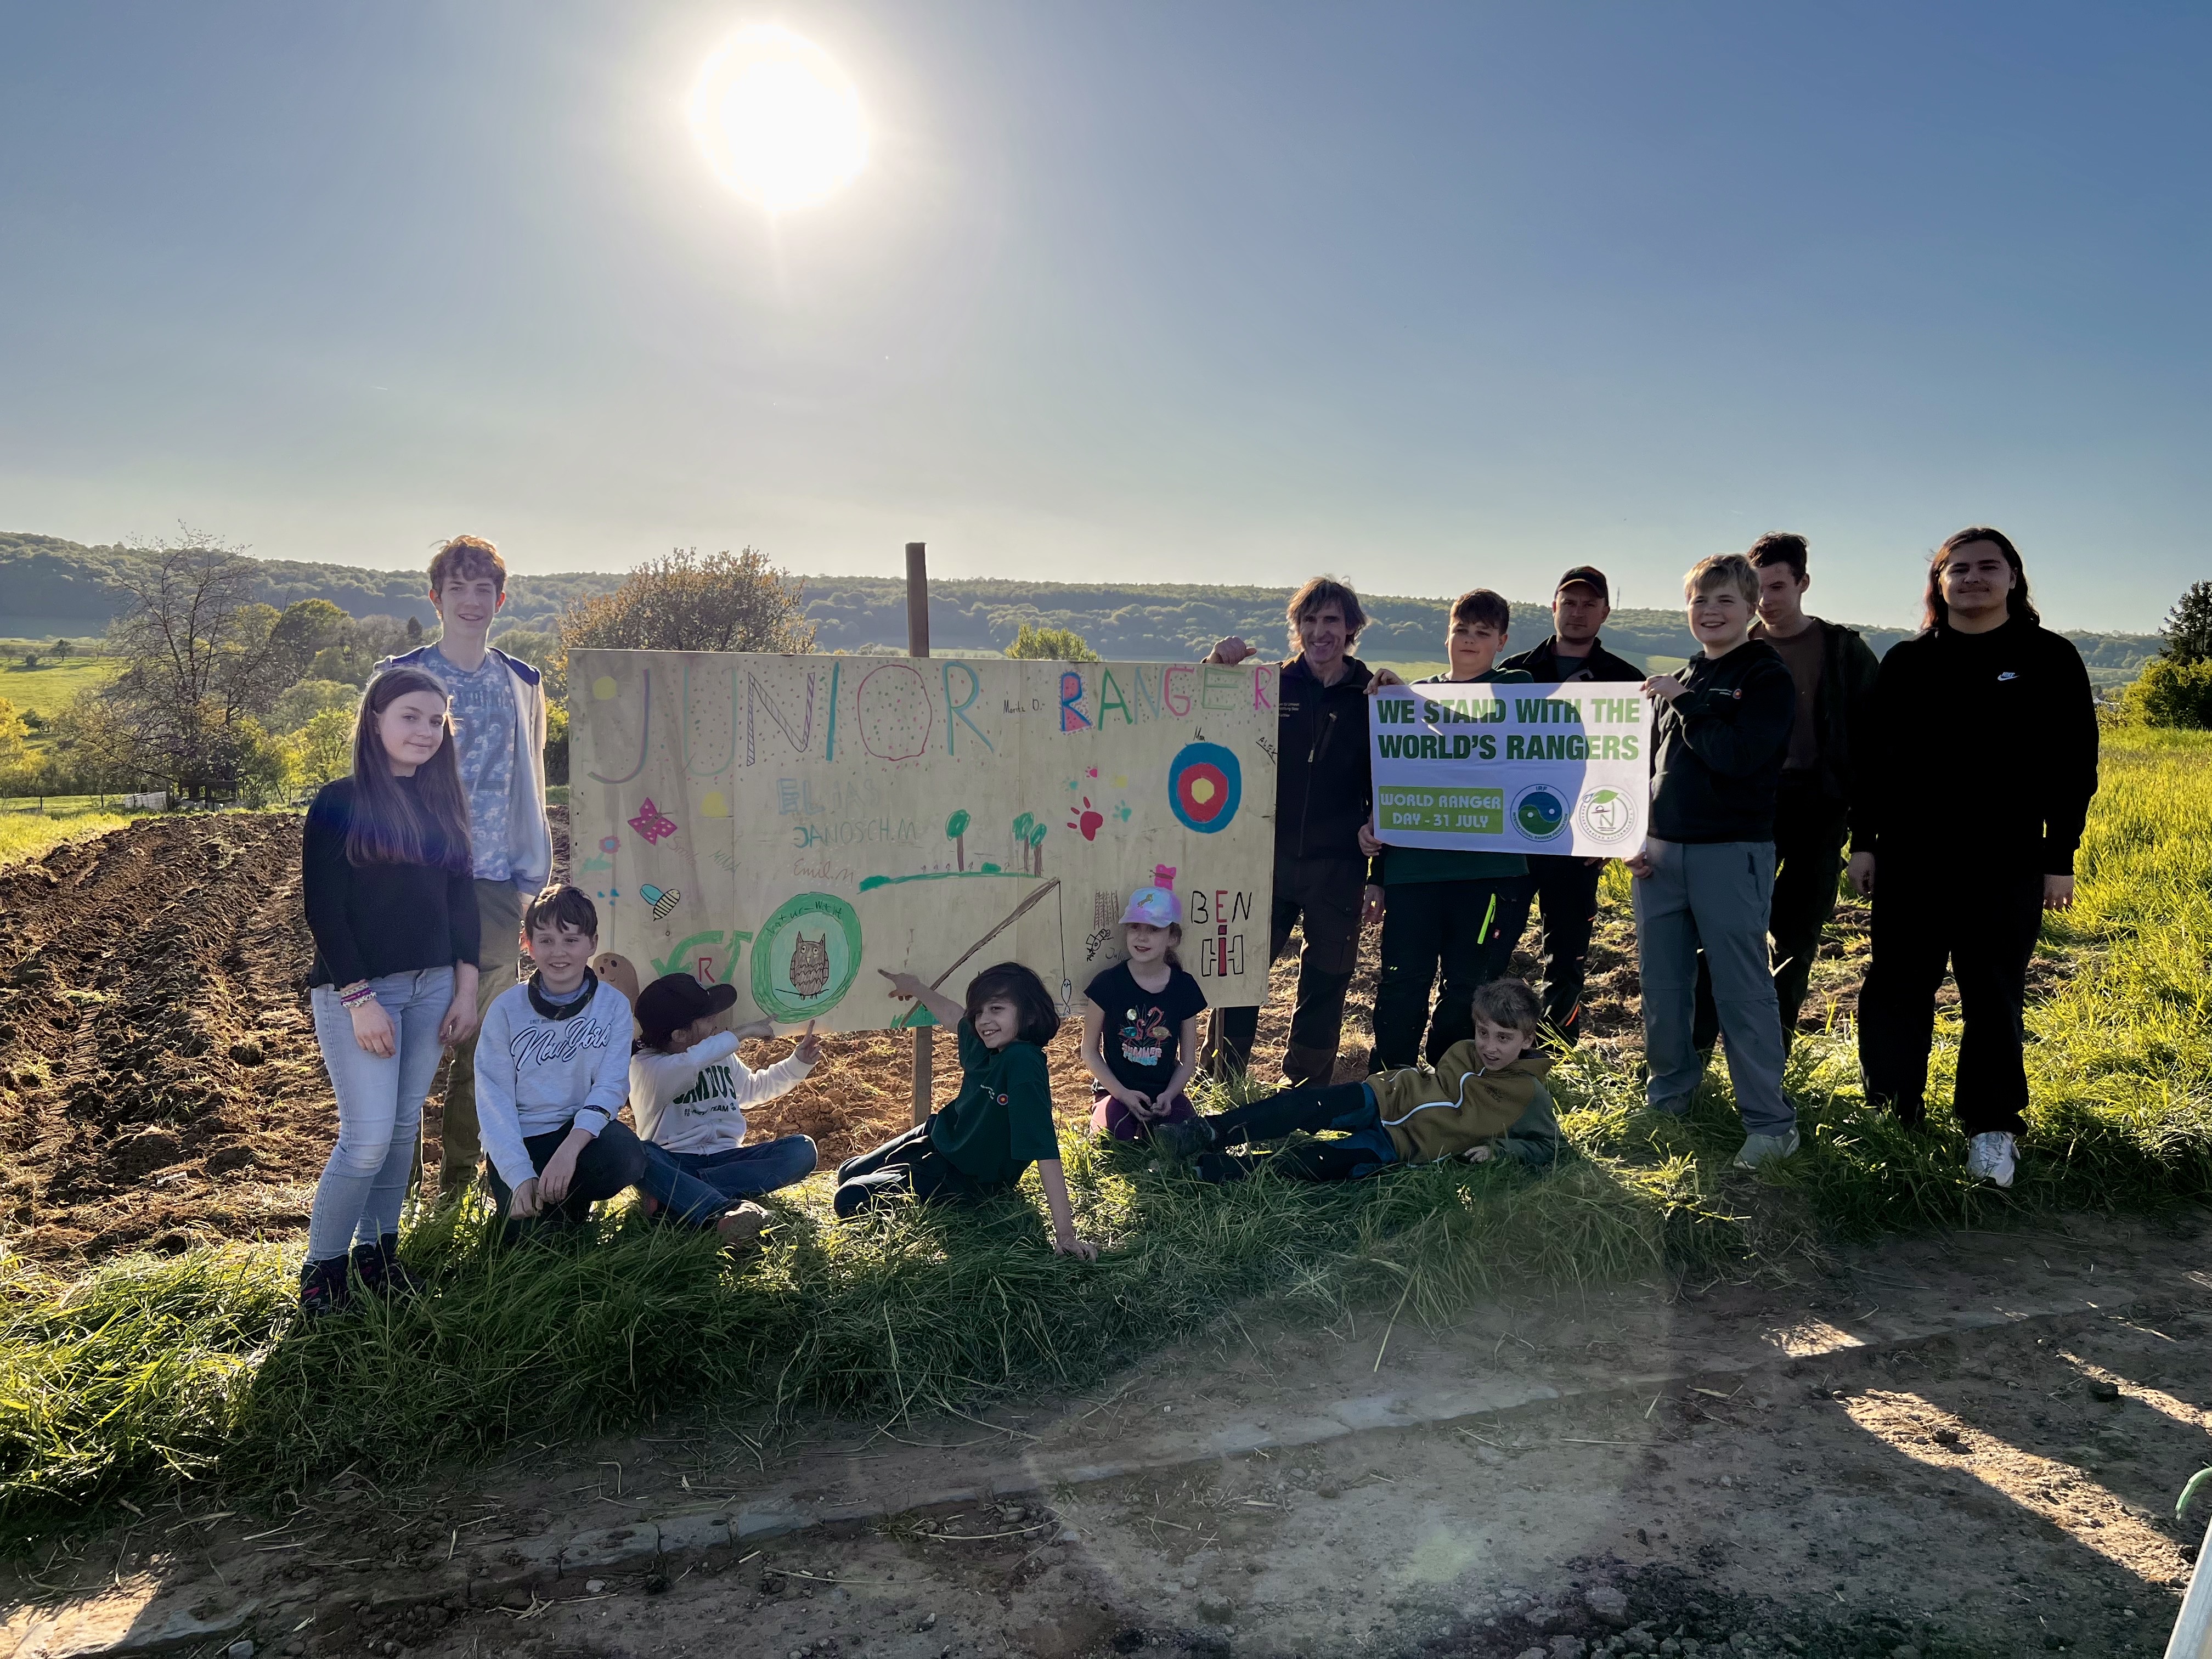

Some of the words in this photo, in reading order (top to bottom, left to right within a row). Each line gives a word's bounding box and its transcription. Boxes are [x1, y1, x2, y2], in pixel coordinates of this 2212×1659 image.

[1003, 700, 1025, 713] Moritz
[1376, 699, 1415, 723] WE
[1424, 699, 1506, 723] STAND
[1515, 699, 1581, 723] WITH
[1590, 698, 1640, 723] THE
[588, 662, 994, 783] JUNIOR
[1060, 666, 1272, 732] RANGER
[1377, 735, 1496, 759] WORLD'S
[1506, 735, 1639, 760] RANGERS
[1380, 794, 1434, 807] WORLD
[1438, 795, 1501, 809] RANGER
[1392, 812, 1421, 825] DAY
[1434, 814, 1449, 827] 31
[1455, 815, 1488, 828] JULY
[1191, 890, 1252, 924] BEN
[698, 957, 715, 983] R
[511, 1026, 567, 1071] New
[562, 1017, 612, 1062] York
